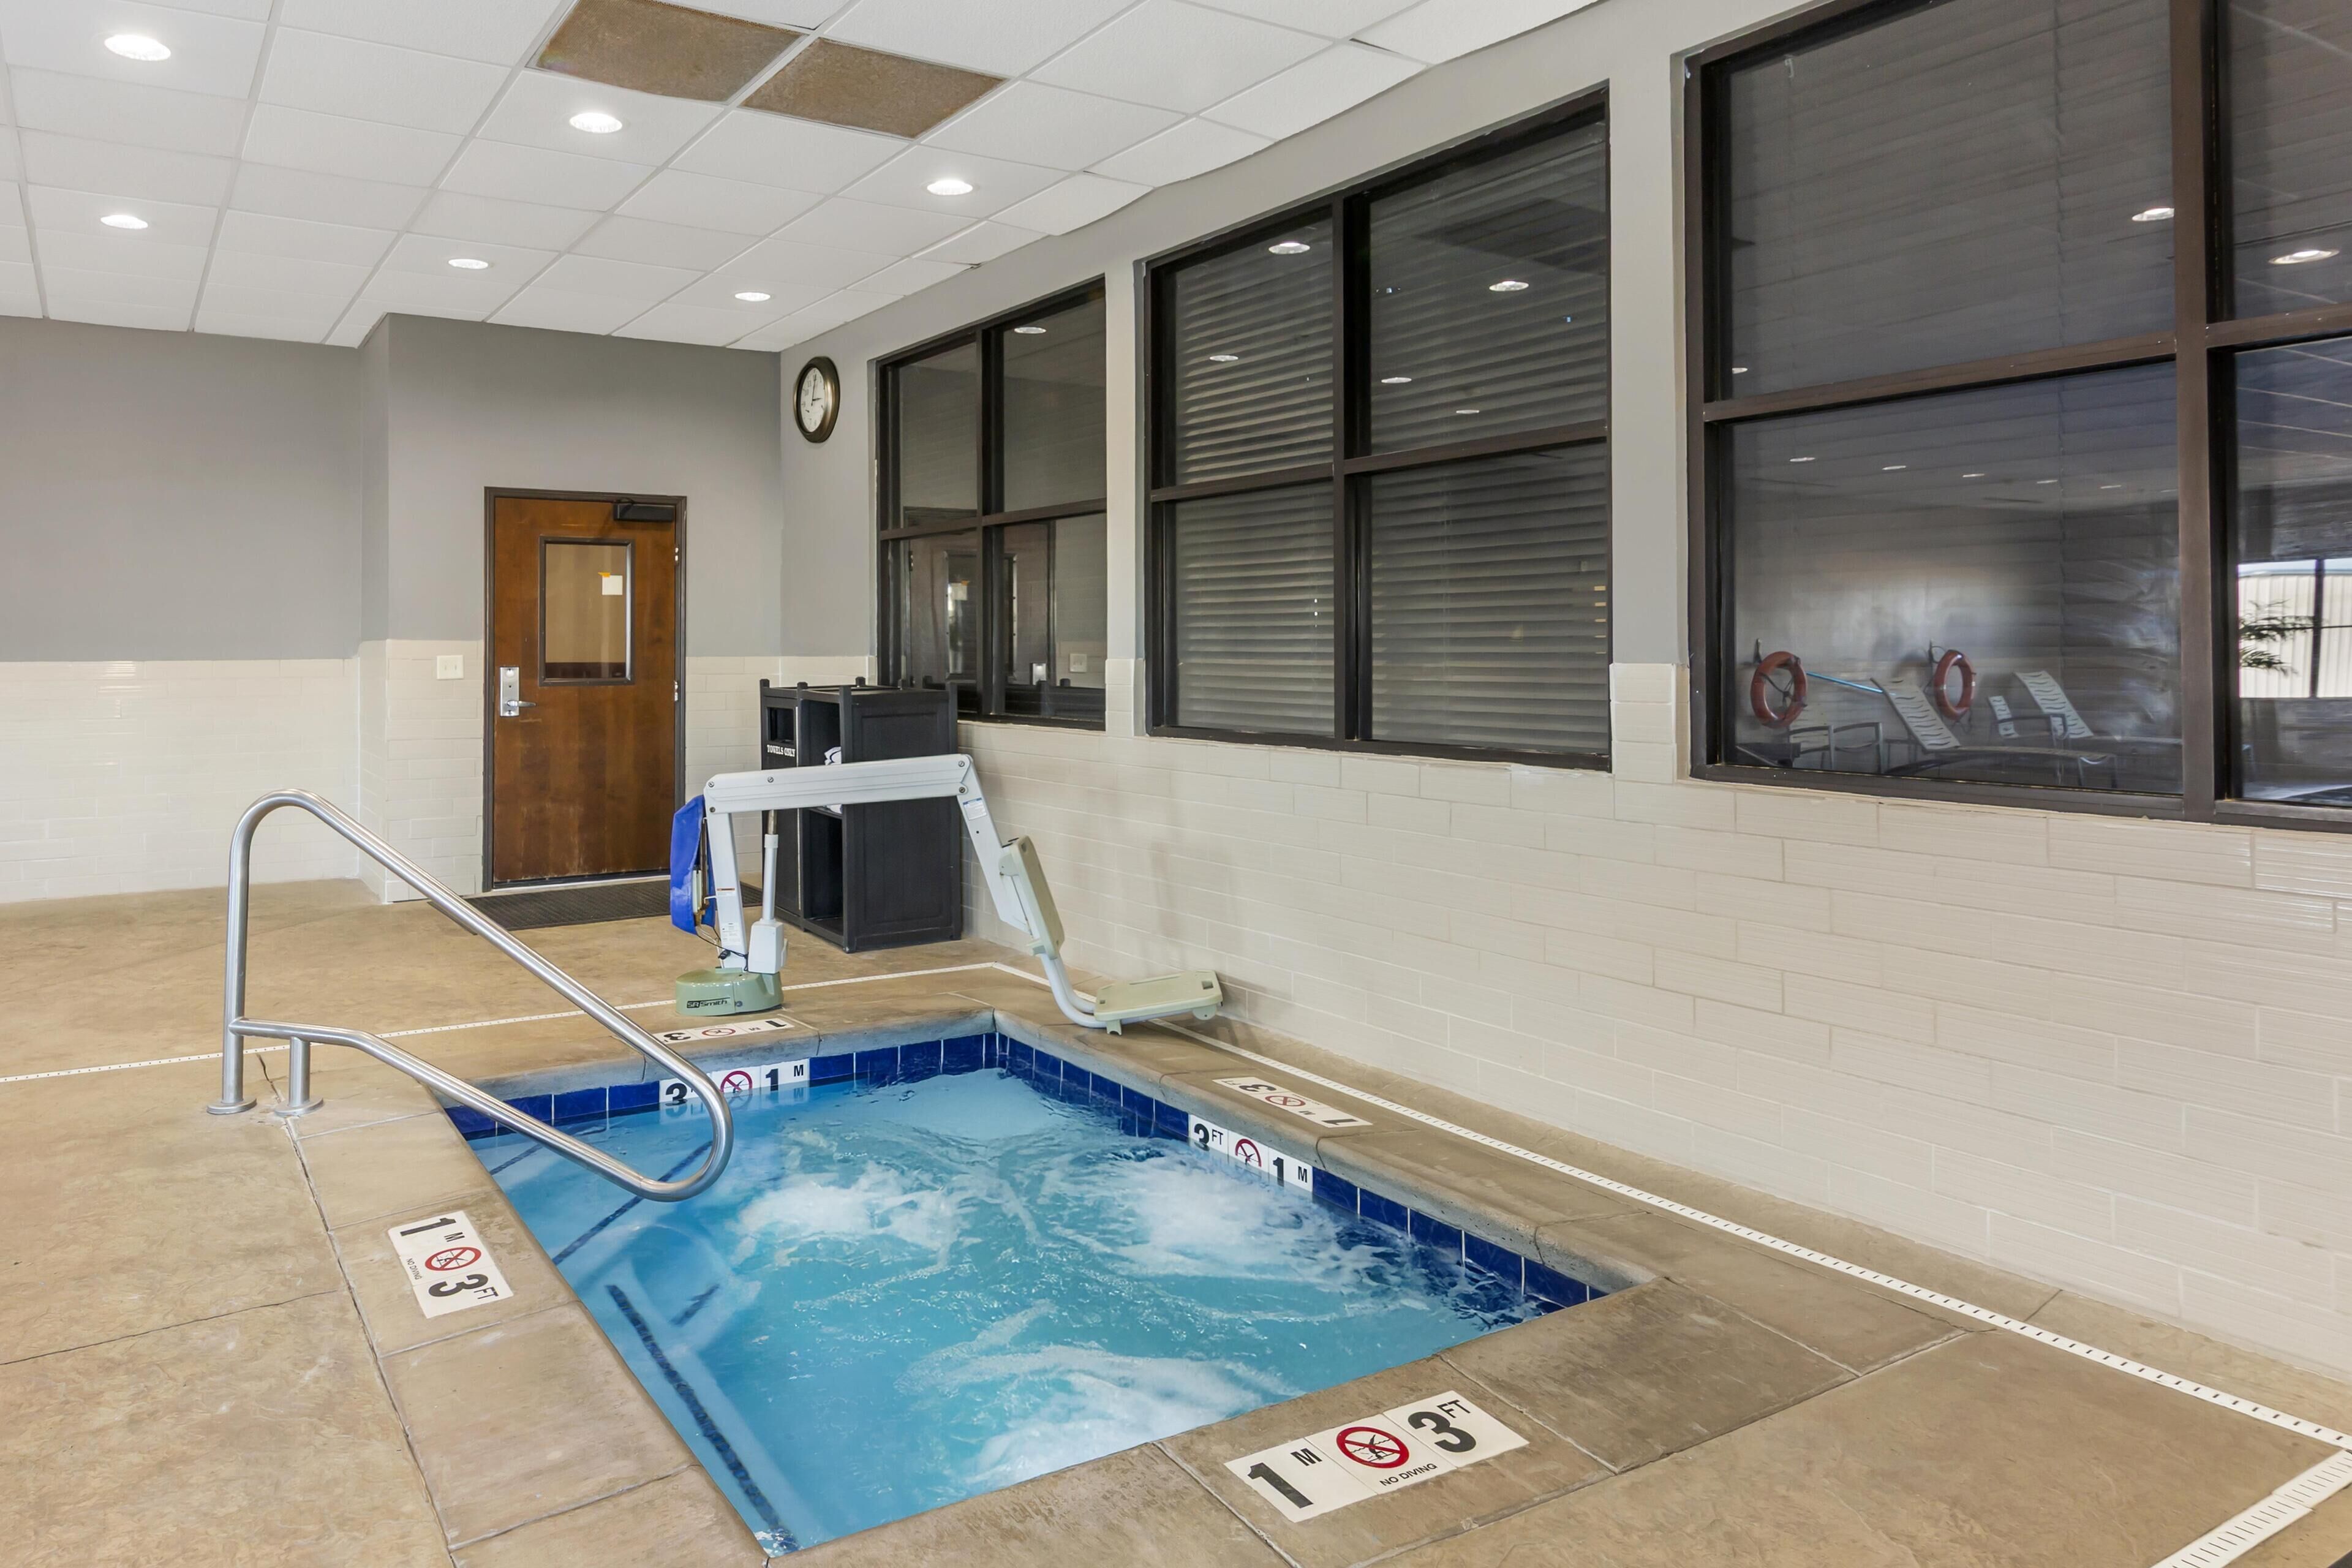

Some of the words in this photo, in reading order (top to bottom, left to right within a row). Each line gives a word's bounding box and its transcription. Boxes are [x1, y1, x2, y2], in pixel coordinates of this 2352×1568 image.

[767, 744, 783, 755] TOWELS
[784, 747, 795, 757] ONLY
[766, 1069, 778, 1091] 1
[793, 1065, 804, 1077] M
[666, 1083, 687, 1106] 3
[1194, 1123, 1210, 1152] 3
[1212, 1128, 1223, 1145] FT
[1273, 1157, 1284, 1186] 1
[1297, 1166, 1307, 1183] M
[400, 1218, 456, 1237] 1
[443, 1232, 465, 1242] M
[409, 1265, 422, 1280] DIVING
[428, 1273, 488, 1297] 3
[473, 1287, 499, 1300] FT
[1436, 1399, 1471, 1419] FT
[1408, 1411, 1477, 1453] 3
[1247, 1462, 1313, 1509] 1
[1291, 1448, 1322, 1466] M
[1379, 1476, 1399, 1487] NO
[1398, 1463, 1438, 1480] DIVING
